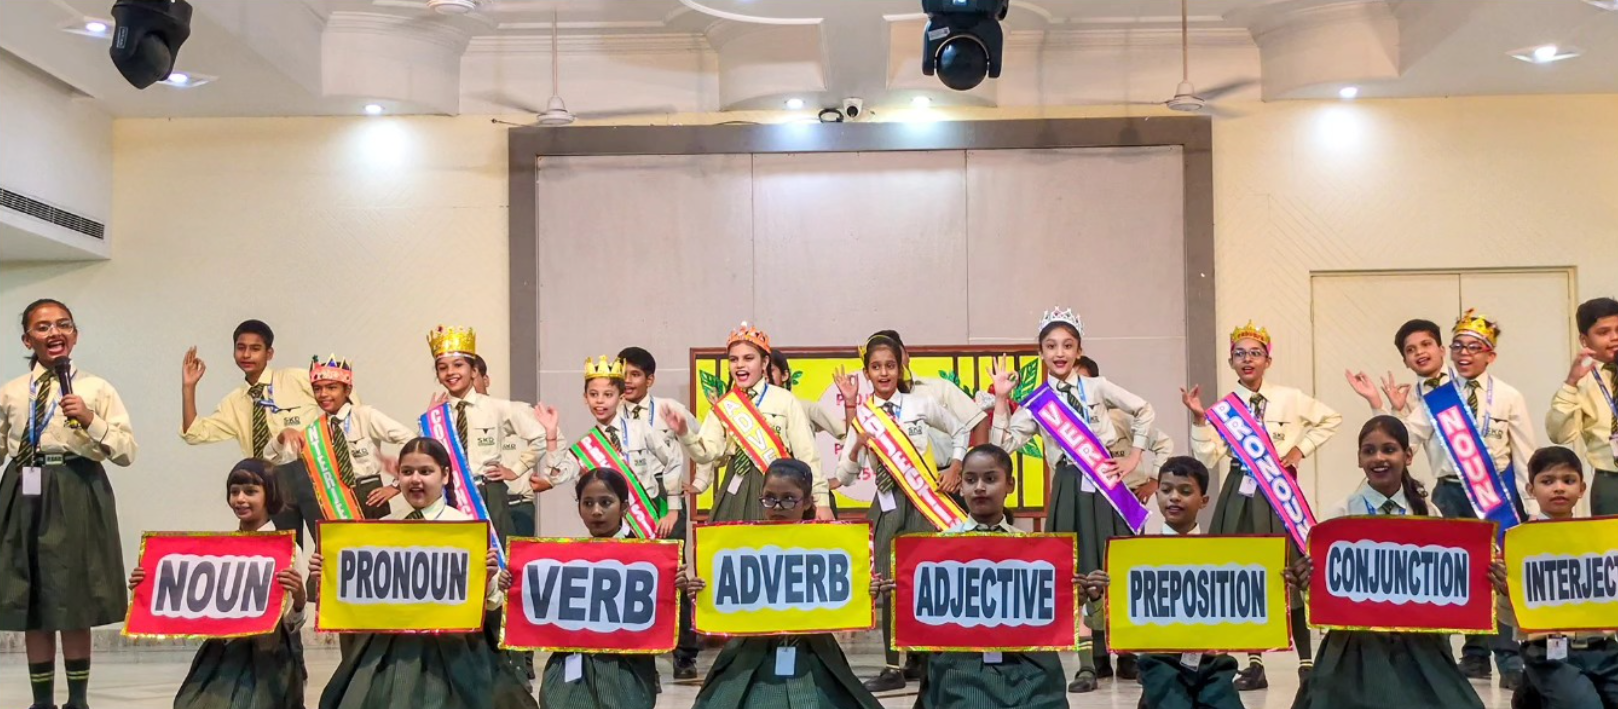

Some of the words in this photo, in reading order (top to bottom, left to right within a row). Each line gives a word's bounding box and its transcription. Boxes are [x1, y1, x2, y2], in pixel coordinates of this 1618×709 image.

[1040, 400, 1120, 489] VERB
[1439, 407, 1502, 510] NOUN
[155, 560, 274, 613] NOUN
[340, 550, 468, 600] PRONOUN
[527, 564, 655, 624] VERB
[715, 553, 849, 605] ADVERB
[916, 566, 1054, 620] ADJECTIVE
[1130, 570, 1265, 618] PREPOSITION
[1329, 546, 1468, 598] CONJUNCTION
